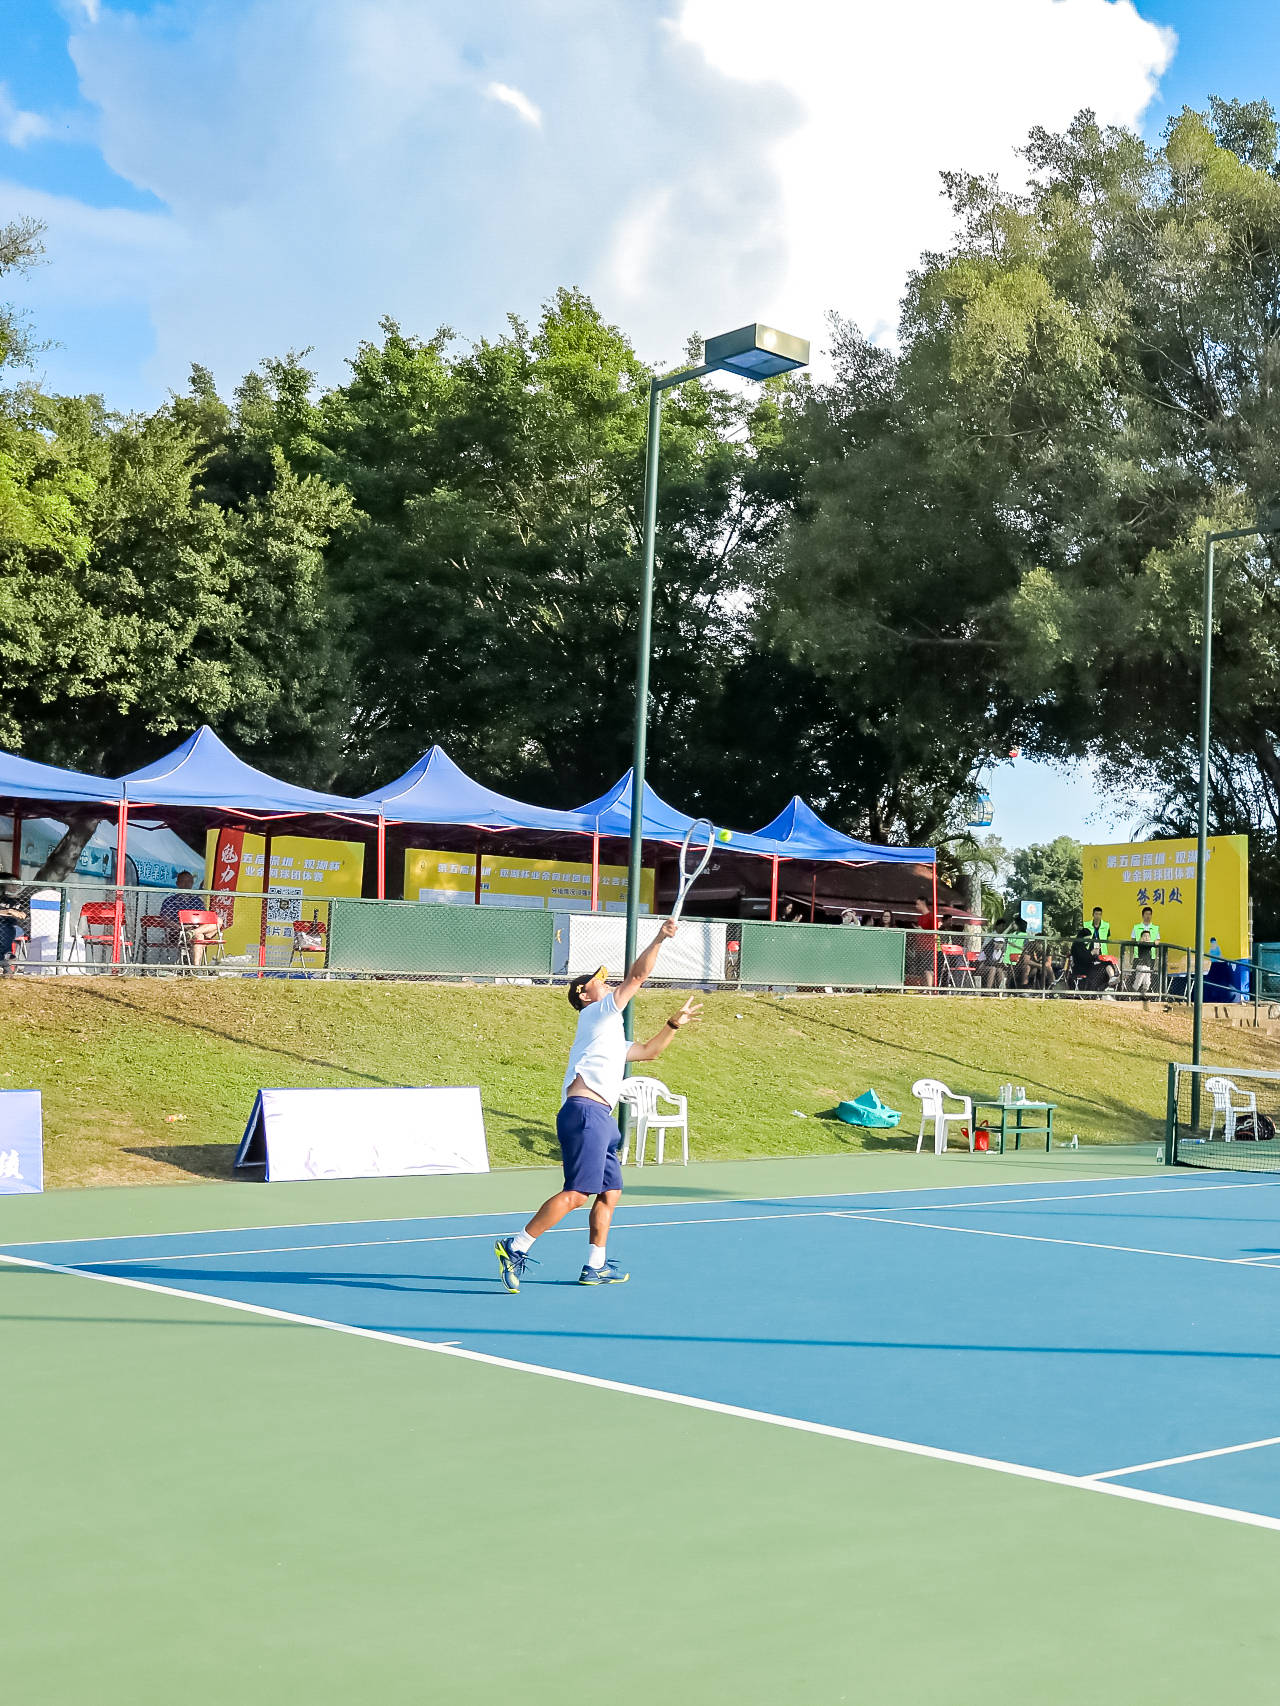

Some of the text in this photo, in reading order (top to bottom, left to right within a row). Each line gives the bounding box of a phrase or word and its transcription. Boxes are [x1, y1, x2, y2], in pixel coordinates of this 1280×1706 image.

[1122, 866, 1195, 882] 业余网球团体赛
[1136, 886, 1183, 906] 签到处
